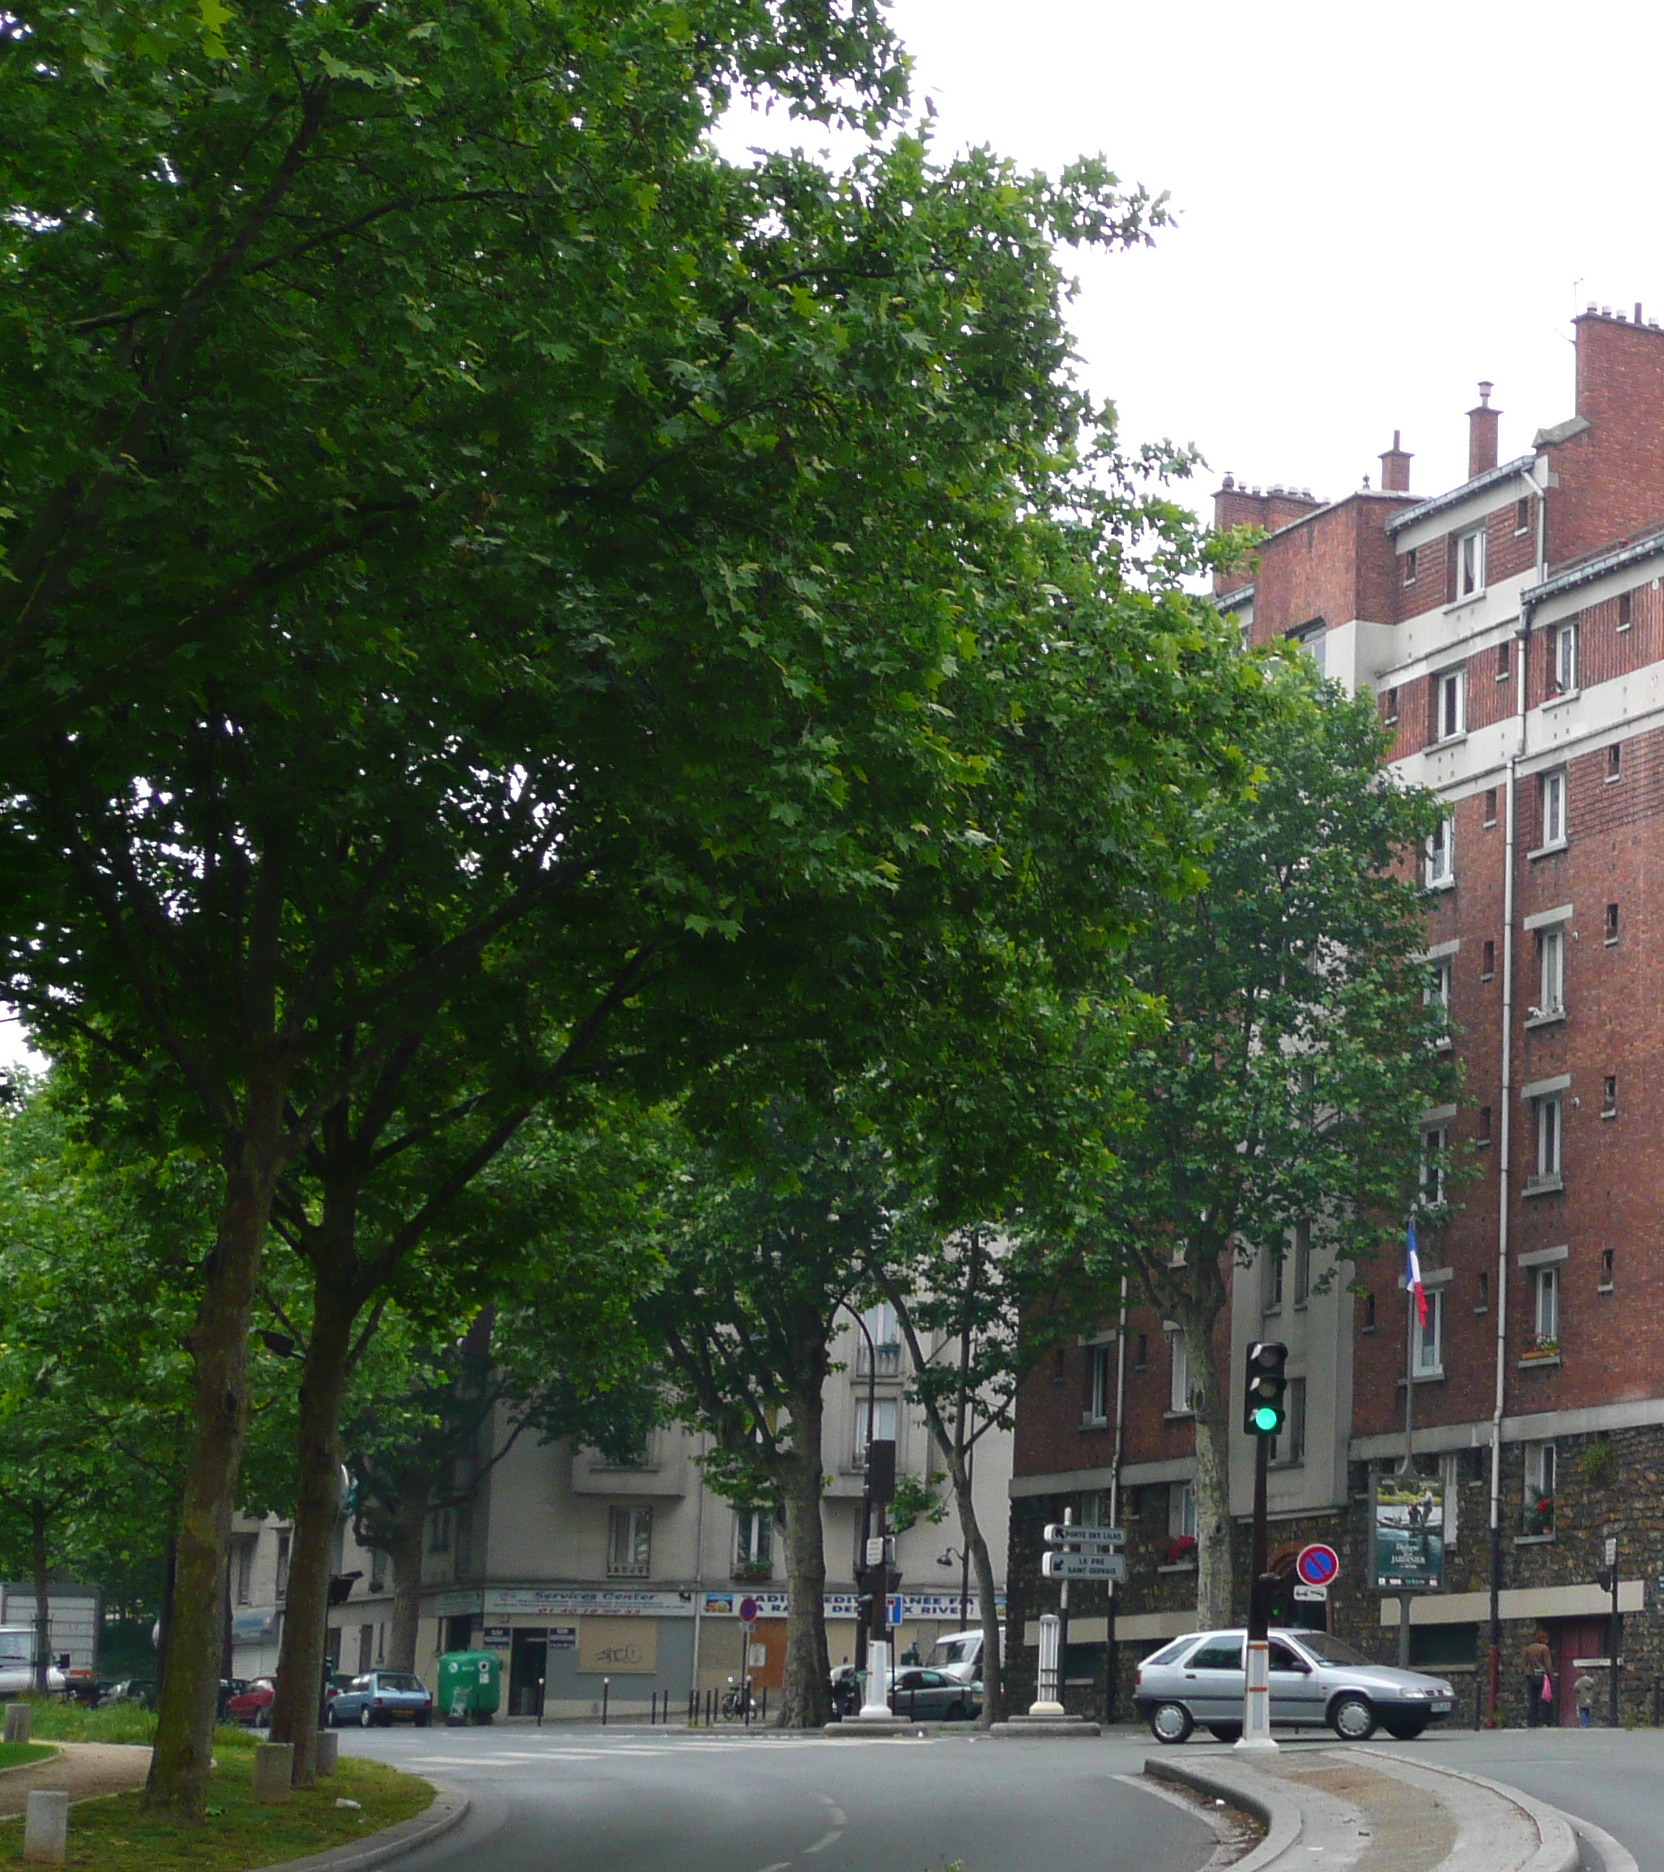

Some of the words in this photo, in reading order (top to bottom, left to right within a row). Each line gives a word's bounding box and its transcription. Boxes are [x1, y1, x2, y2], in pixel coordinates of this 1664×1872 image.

[1066, 1531, 1086, 1539] PORTE
[1088, 1531, 1101, 1539] DES
[1103, 1532, 1122, 1540] LILAS
[1078, 1557, 1088, 1565] LE
[534, 1590, 598, 1600] Services
[602, 1590, 657, 1600] Center
